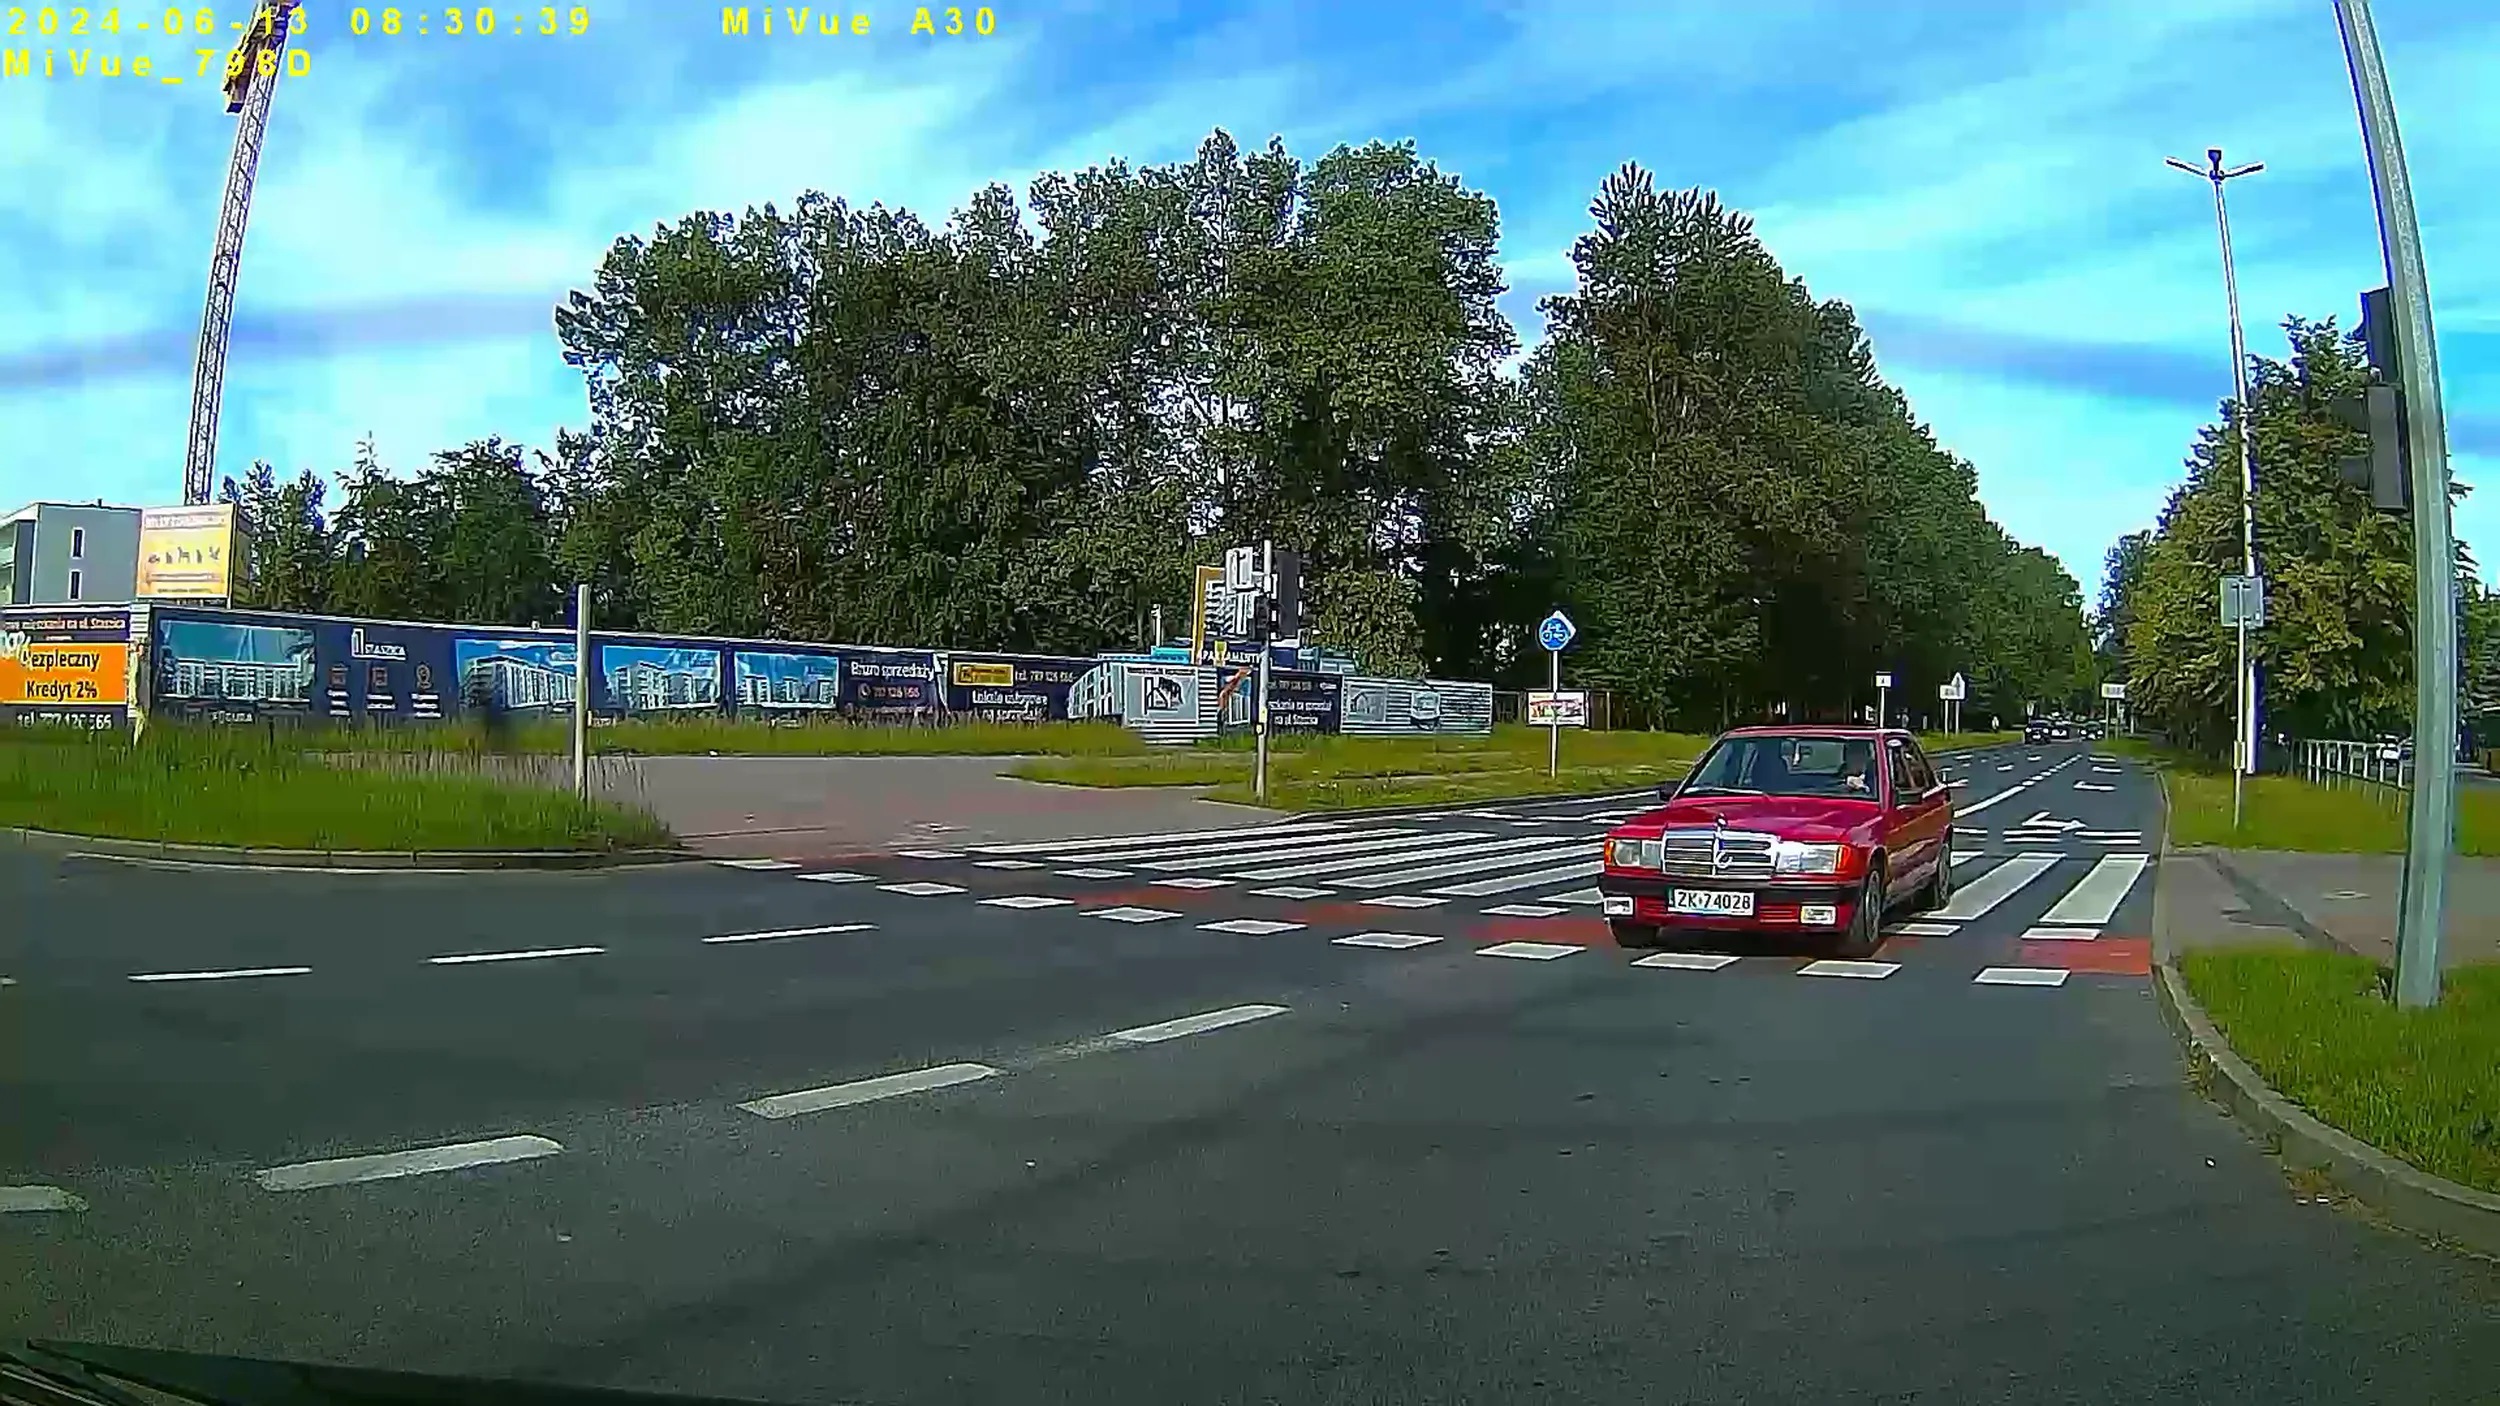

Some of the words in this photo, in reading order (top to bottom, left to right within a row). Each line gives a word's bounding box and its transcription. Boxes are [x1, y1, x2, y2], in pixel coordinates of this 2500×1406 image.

[26, 681, 72, 702] Kredyt
[76, 681, 99, 698] 2%
[1703, 893, 1751, 910] 74028
